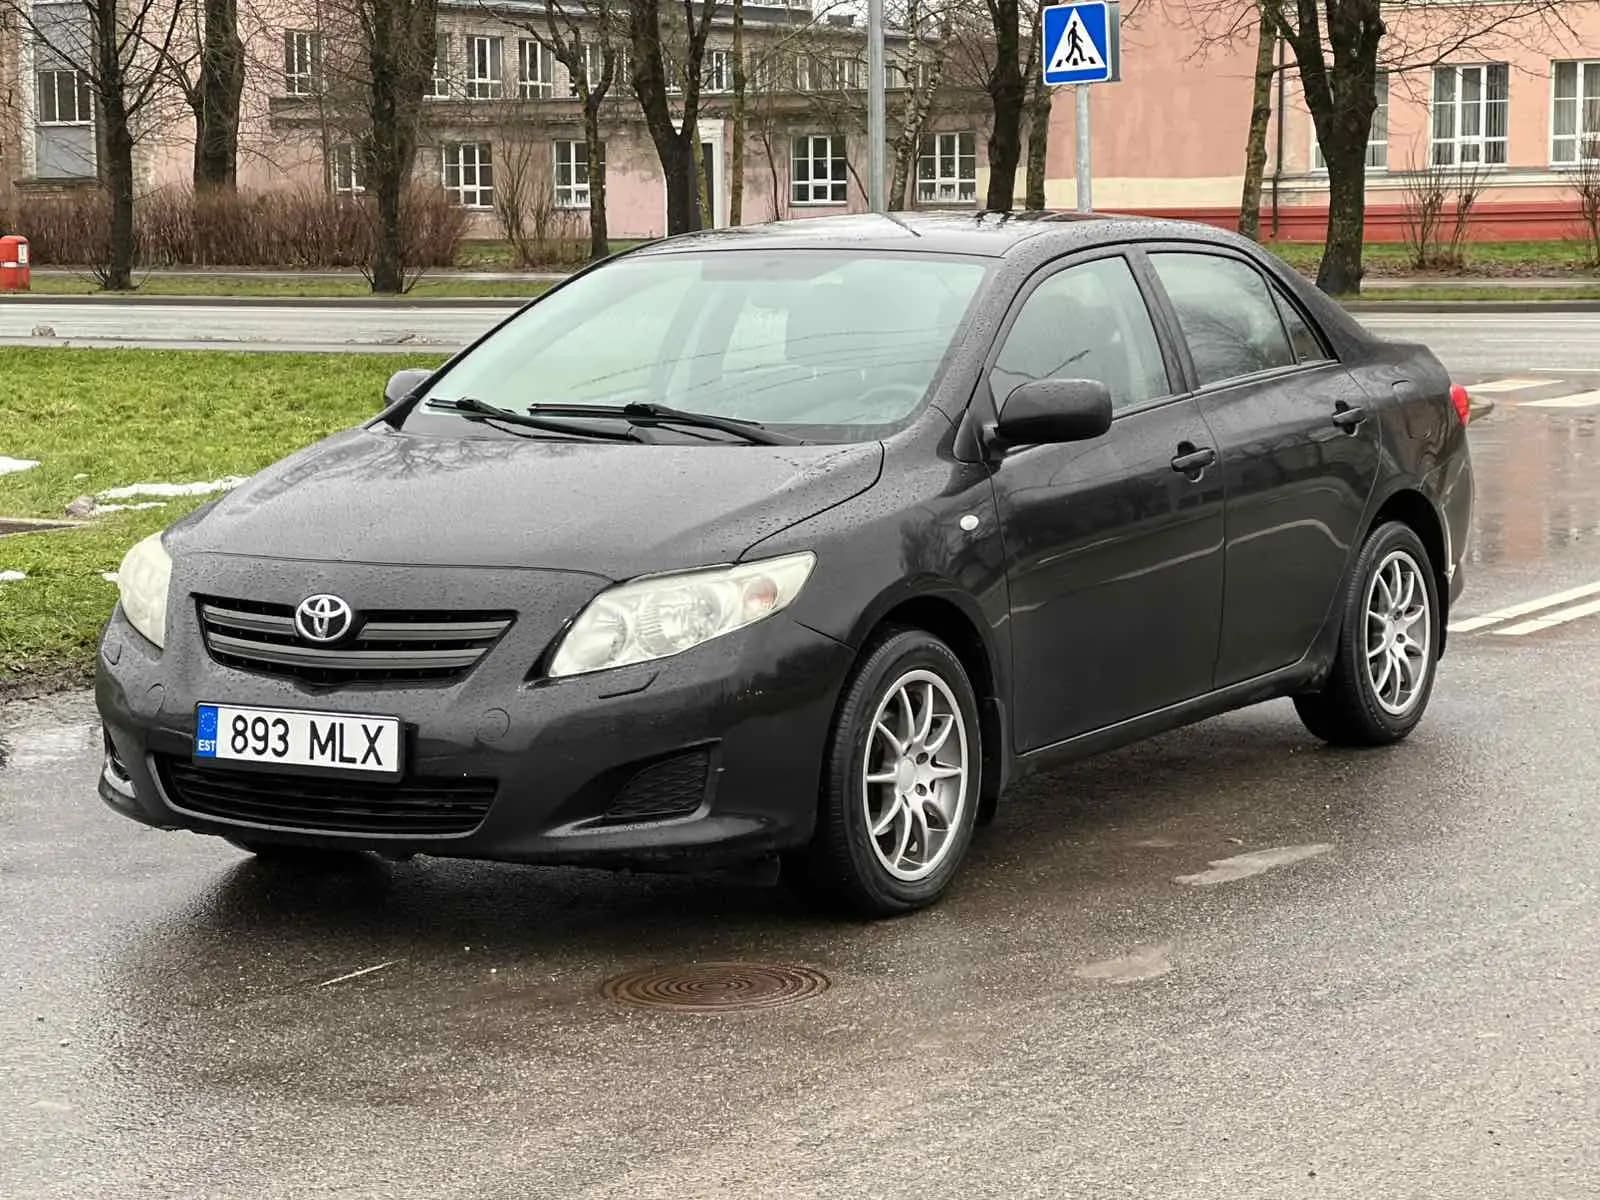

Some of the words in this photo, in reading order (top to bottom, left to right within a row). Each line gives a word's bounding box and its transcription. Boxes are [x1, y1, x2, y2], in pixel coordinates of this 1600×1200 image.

[198, 739, 216, 752] EST
[231, 714, 289, 757] 893
[309, 720, 384, 766] MLX
